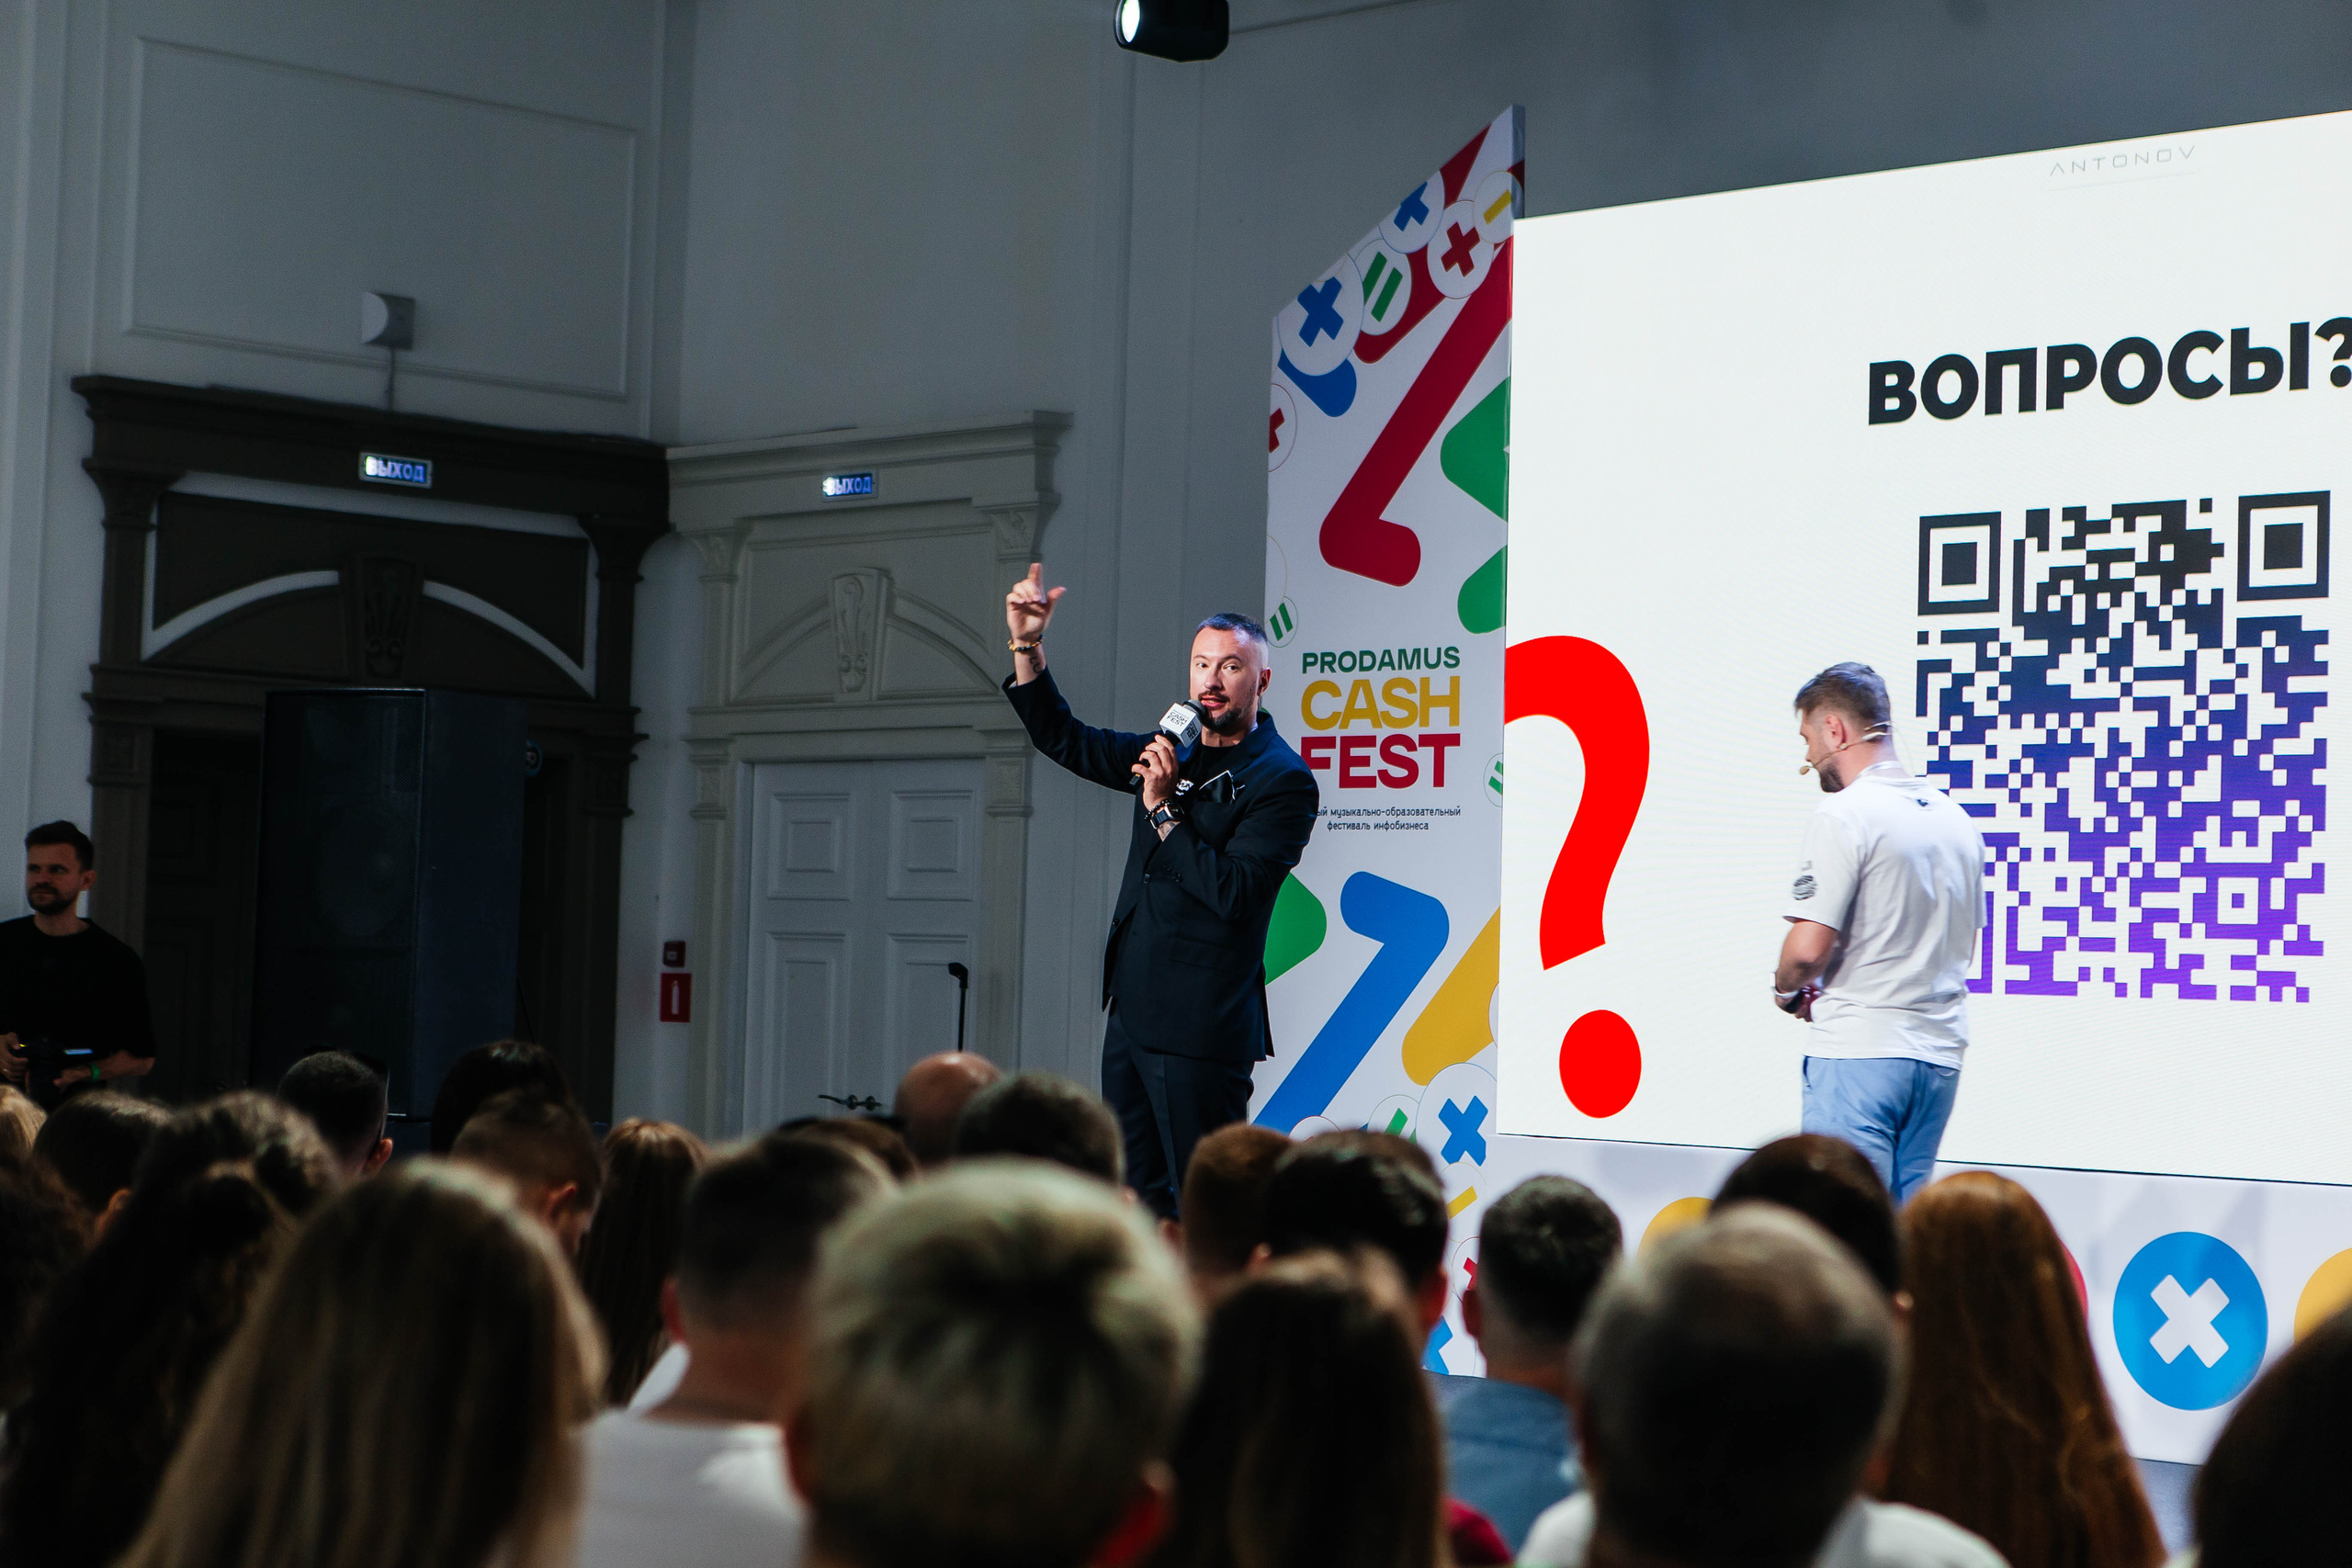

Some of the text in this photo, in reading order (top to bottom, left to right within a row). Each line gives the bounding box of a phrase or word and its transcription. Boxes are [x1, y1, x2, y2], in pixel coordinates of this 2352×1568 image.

[2050, 144, 2195, 176] ANTONOV
[1868, 316, 2352, 425] ВОПРОСЫ?
[1302, 646, 1461, 674] PRODAMUS
[1301, 675, 1461, 730] CASH
[1301, 733, 1461, 789] FEST
[1327, 820, 1429, 832] фестиваль инфобизнеса
[1330, 806, 1461, 818] музыкально-образовательный
